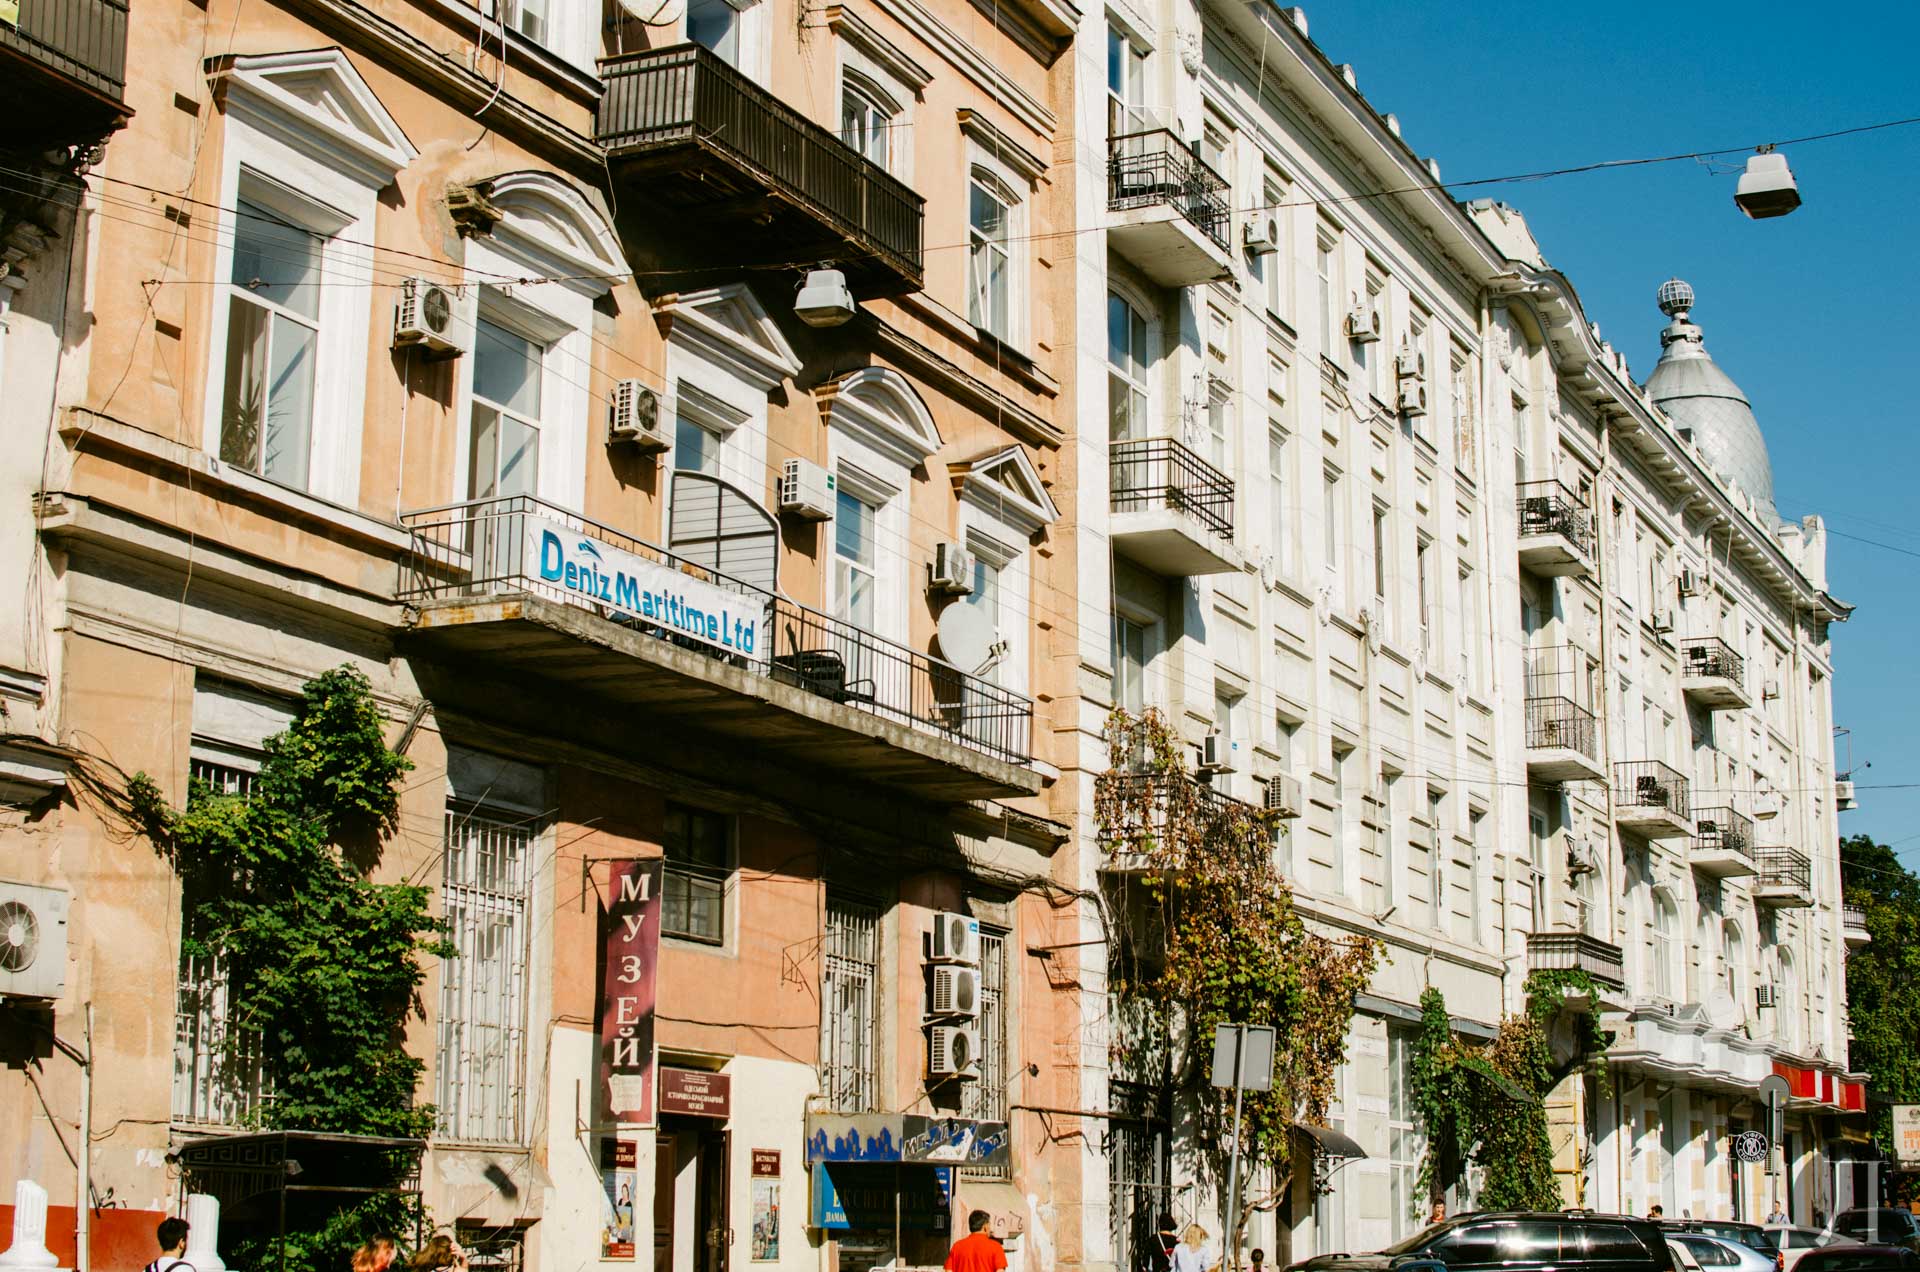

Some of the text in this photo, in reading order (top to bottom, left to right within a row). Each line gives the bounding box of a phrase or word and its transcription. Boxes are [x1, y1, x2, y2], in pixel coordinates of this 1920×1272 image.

[540, 529, 755, 654] Deniz Maritime Ltd
[612, 874, 651, 1066] МУЗЕЙ
